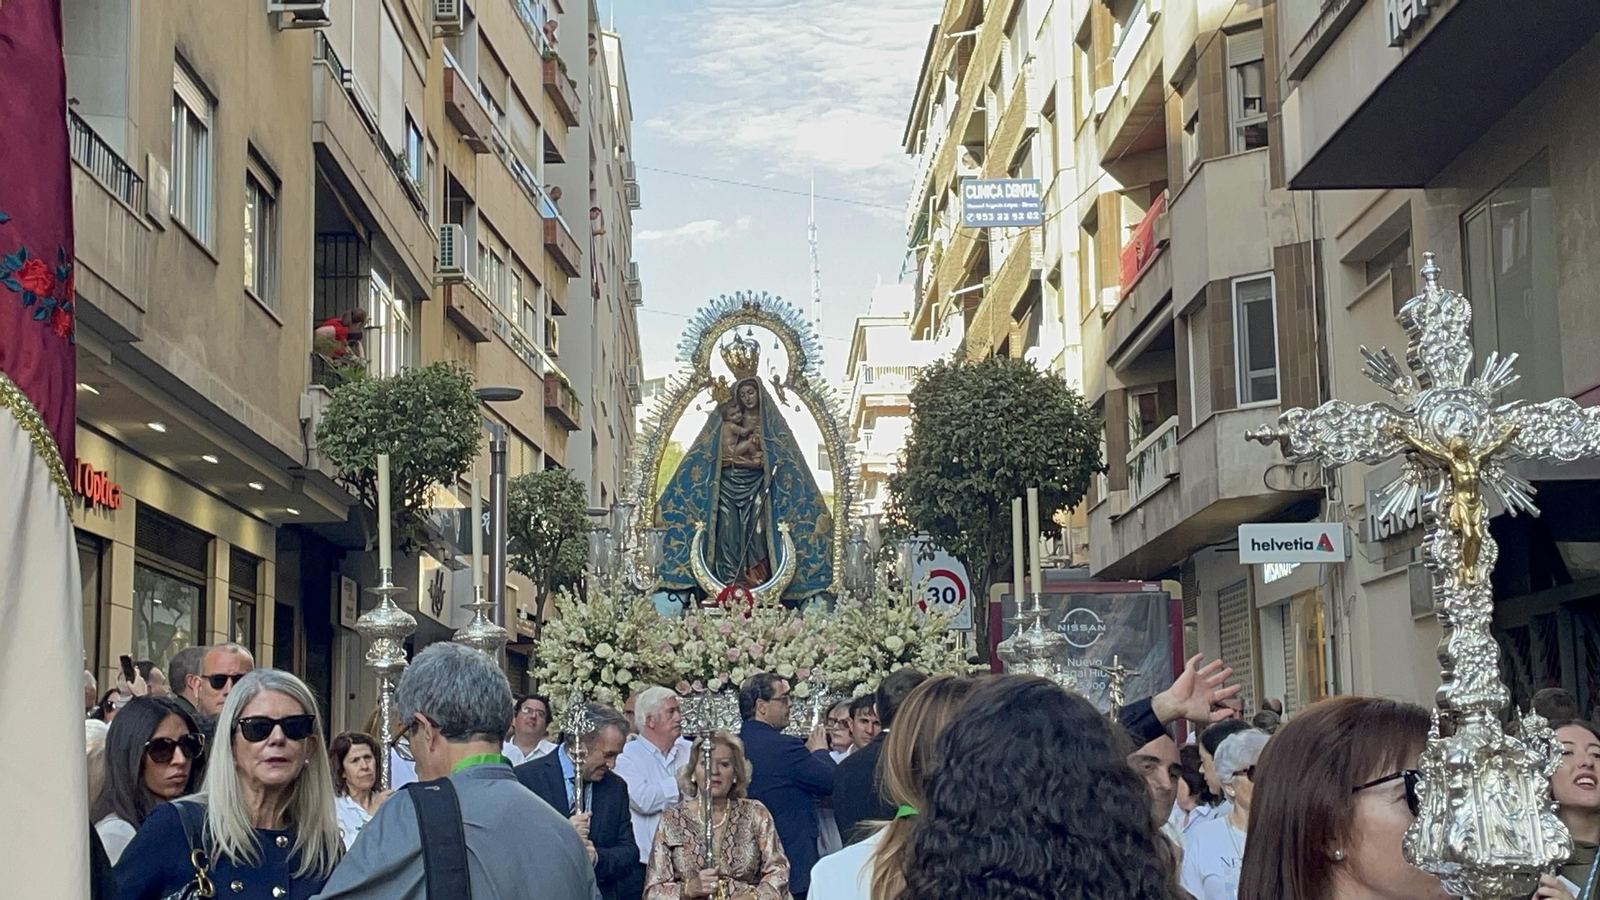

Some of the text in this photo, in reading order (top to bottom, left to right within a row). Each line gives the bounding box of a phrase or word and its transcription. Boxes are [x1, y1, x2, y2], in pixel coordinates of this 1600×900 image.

[1005, 183, 1039, 198] DENTAL
[1251, 537, 1314, 551] helvetia
[927, 586, 956, 604] 30
[1057, 624, 1106, 632] NISSAN
[1067, 658, 1103, 667] Nuevo
